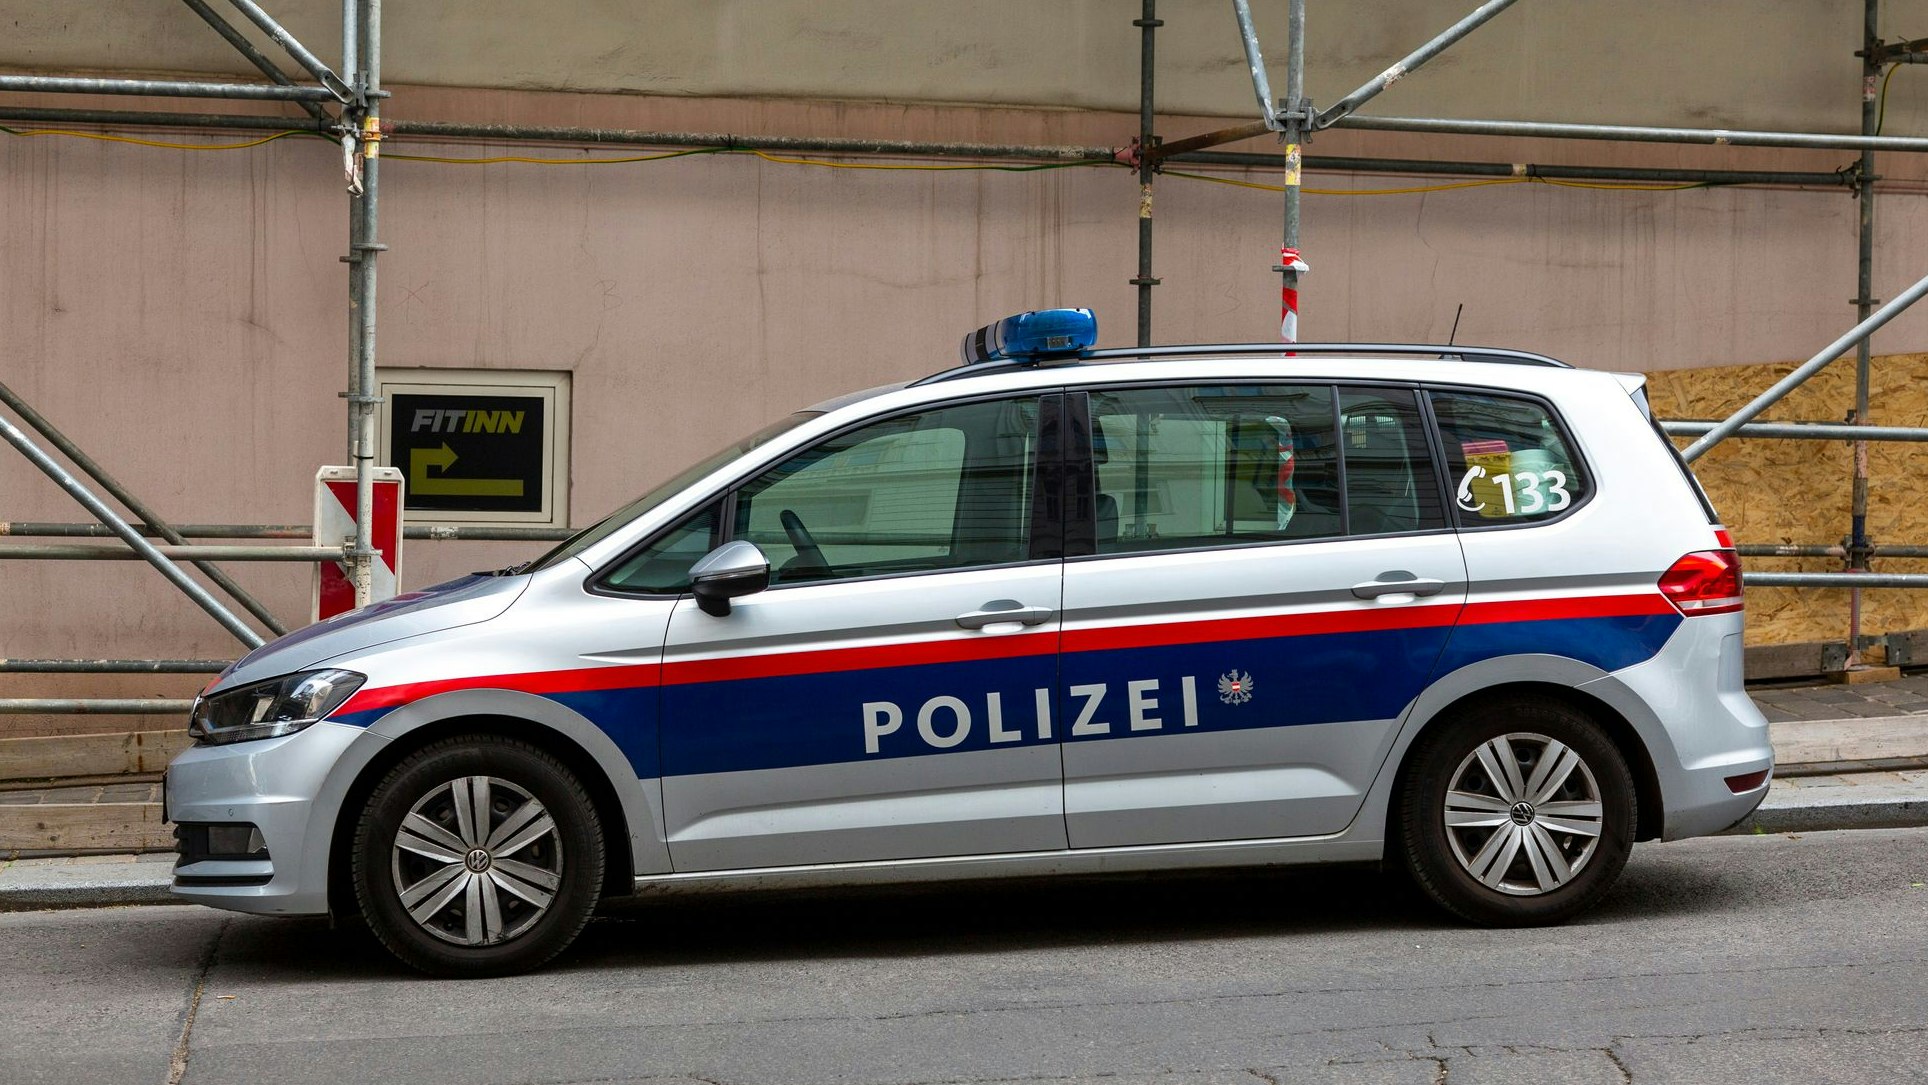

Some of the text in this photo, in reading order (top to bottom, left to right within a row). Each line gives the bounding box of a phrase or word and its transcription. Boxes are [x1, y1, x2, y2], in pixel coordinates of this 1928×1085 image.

[410, 409, 525, 433] FITINN
[1492, 470, 1571, 514] 133
[862, 676, 1198, 754] POLIZEI
